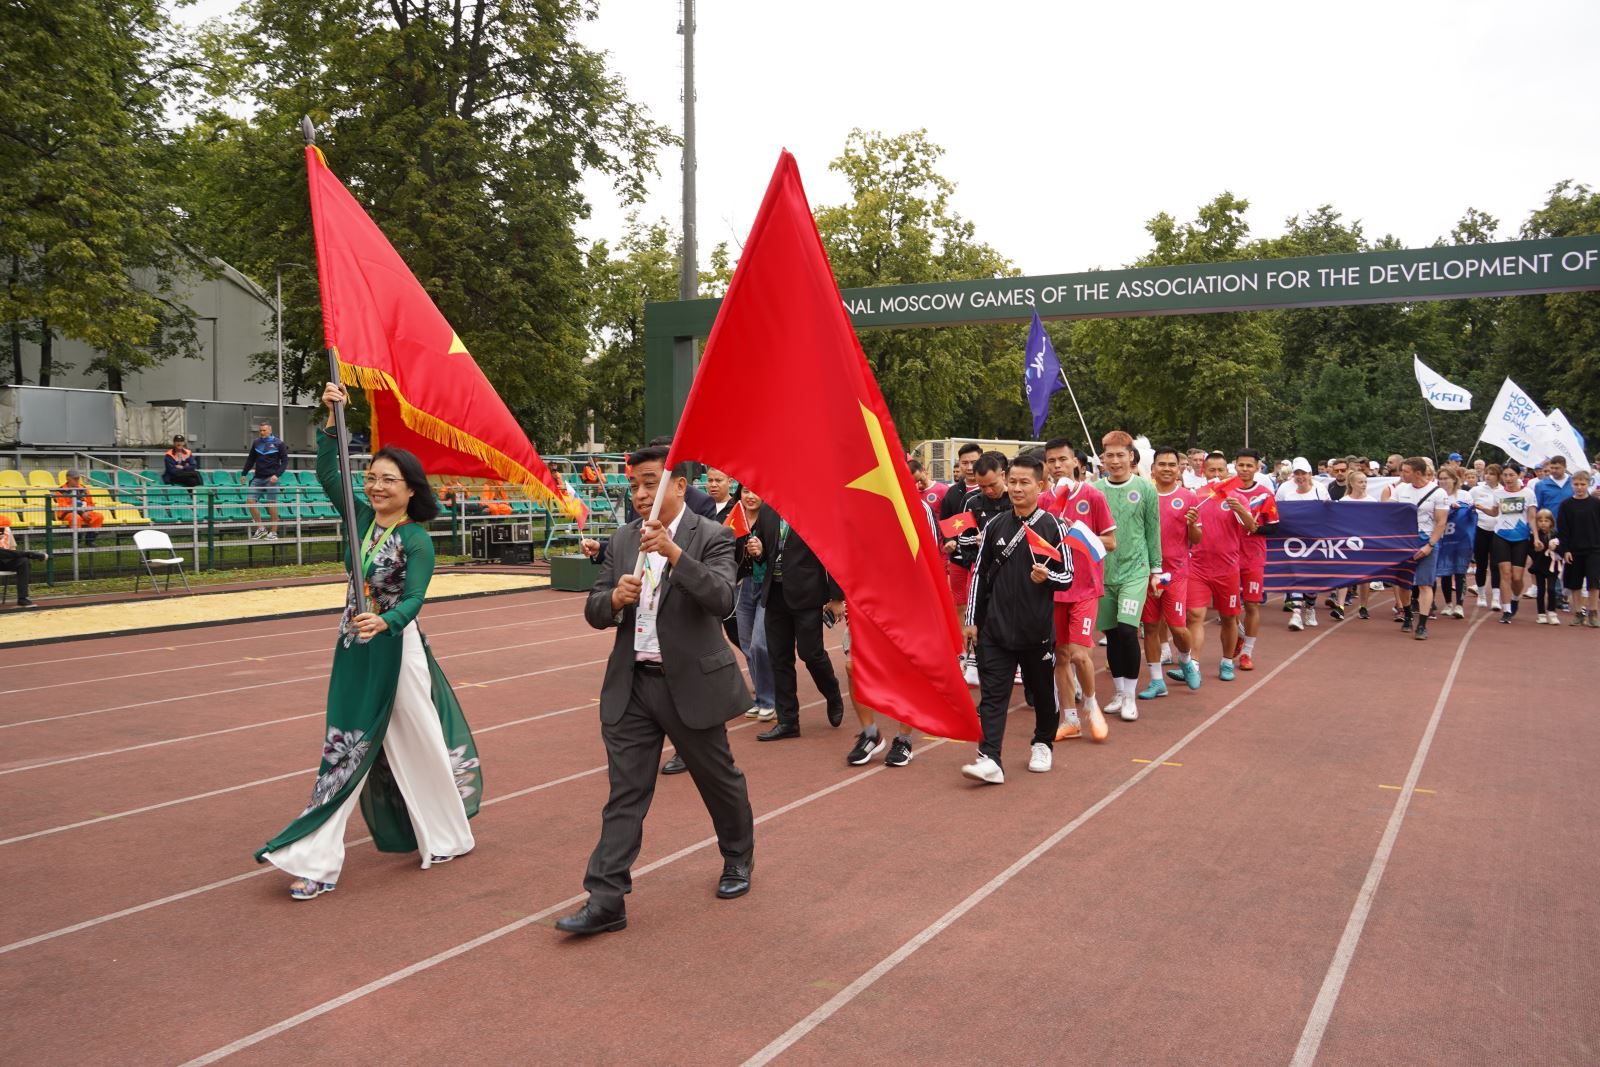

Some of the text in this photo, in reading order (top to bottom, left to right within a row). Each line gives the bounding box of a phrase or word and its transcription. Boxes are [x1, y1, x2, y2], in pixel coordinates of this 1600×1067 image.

[880, 292, 965, 313] MOSCOW
[970, 288, 1035, 308] GAMES
[1041, 286, 1067, 304] OF
[1073, 282, 1109, 301] THE
[1116, 272, 1258, 299] ASSOCIATION
[1266, 270, 1310, 290] FOR
[1317, 266, 1360, 287] THE
[1369, 253, 1553, 285] DEVELOPMENT
[1561, 249, 1598, 272] OF
[1249, 581, 1260, 594] 14
[1121, 598, 1140, 616] 99
[1175, 601, 1183, 616] 4
[1229, 594, 1237, 608] 8
[1082, 617, 1092, 636] 9
